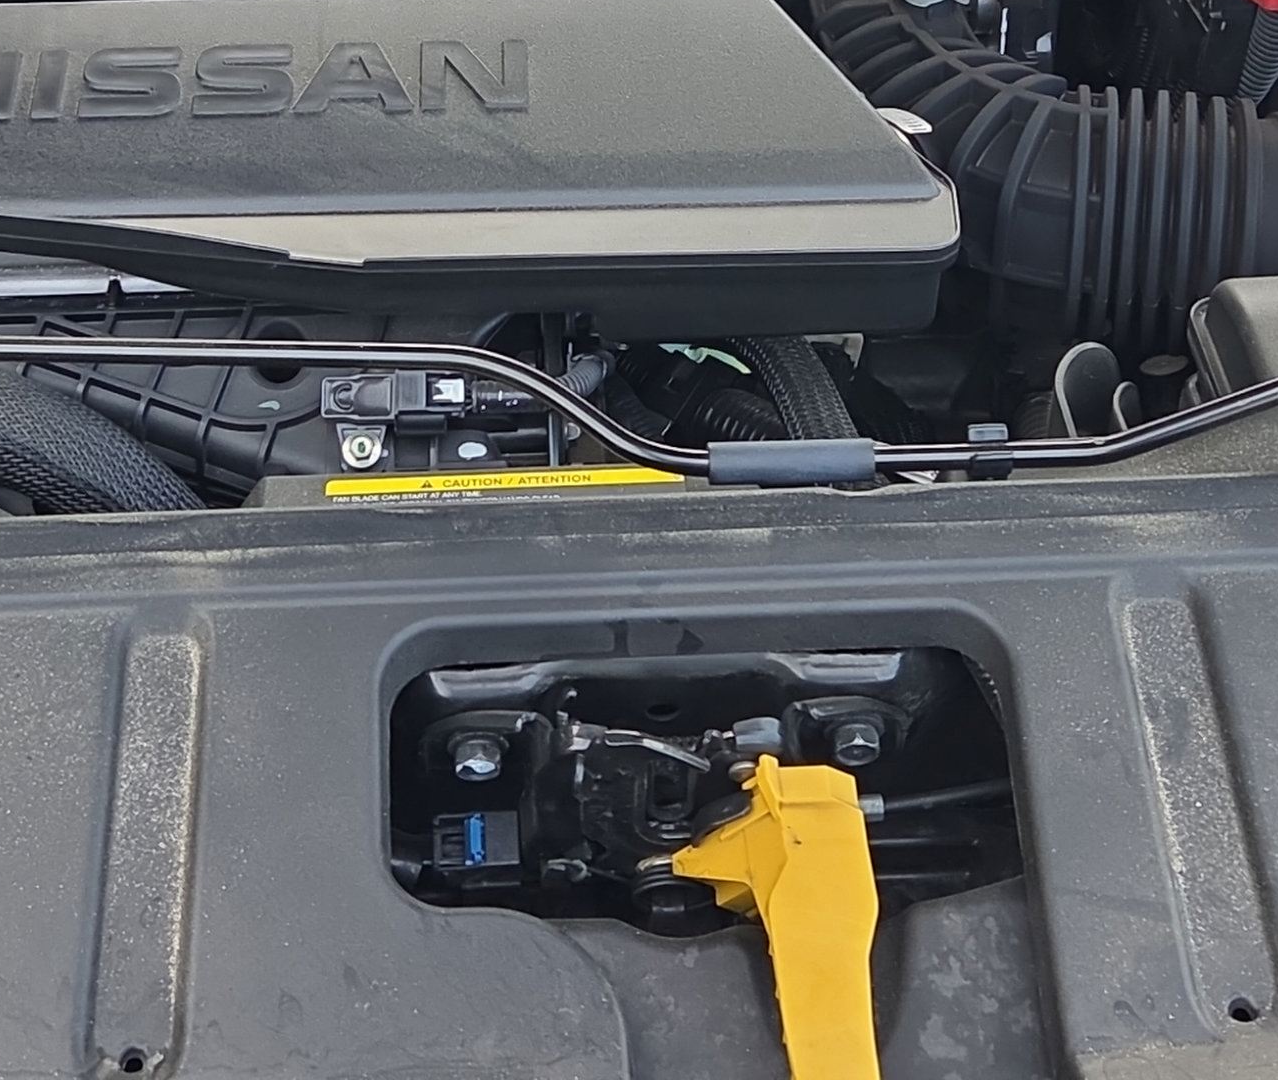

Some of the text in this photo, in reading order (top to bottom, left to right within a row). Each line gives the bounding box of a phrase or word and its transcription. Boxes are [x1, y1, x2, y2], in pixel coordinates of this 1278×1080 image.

[442, 477, 503, 488] CAUTION
[518, 474, 592, 485] ATTENTION
[351, 494, 379, 502] BLADE
[381, 493, 400, 501] CAN
[401, 492, 427, 500] START
[429, 491, 440, 499] AT
